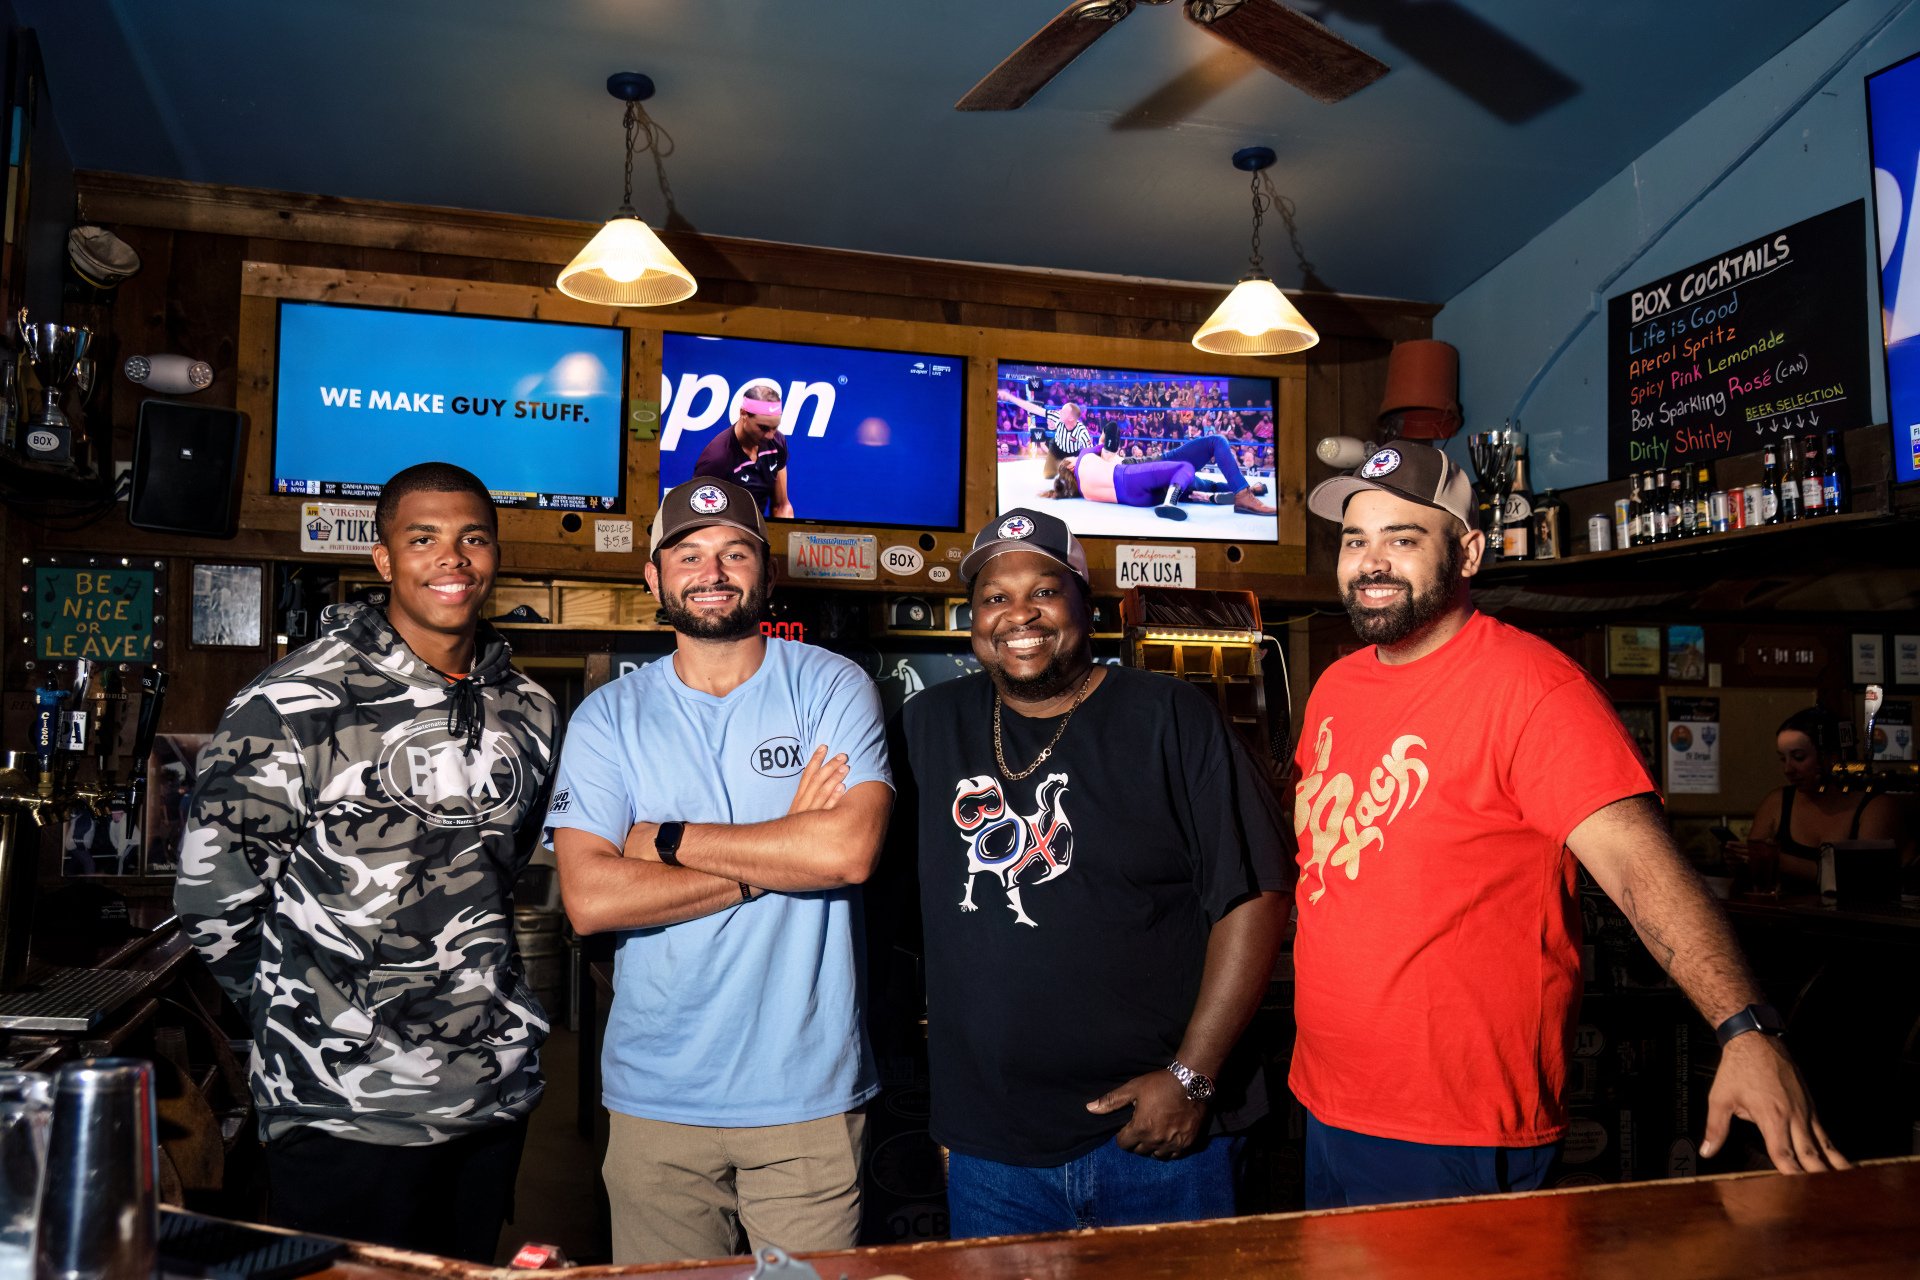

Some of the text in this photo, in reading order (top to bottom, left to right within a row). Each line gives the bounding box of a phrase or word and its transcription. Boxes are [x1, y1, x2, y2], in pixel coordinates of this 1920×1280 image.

[1631, 234, 1790, 324] BOX COCKTAILS
[1629, 291, 1738, 354] Life is Good
[1683, 326, 1736, 361] Spritz
[1631, 329, 1785, 405] Spicy Pink Lemonade
[320, 386, 590, 423] WE MAKE GUY STUFF.
[1631, 408, 1654, 432] Box
[1659, 391, 1727, 427] Sparkling
[1728, 368, 1772, 400] Rosé
[1745, 383, 1845, 421] BEER SELECTION
[32, 435, 52, 446] BOX
[1630, 424, 1732, 468] Dirty Shirley
[330, 508, 376, 518] VIRGINIA
[796, 545, 873, 570] ANDSAL
[889, 553, 915, 568] BOX
[948, 551, 962, 559] BOX
[1132, 549, 1177, 561] California
[76, 573, 111, 595] BE
[933, 570, 946, 578] BOX
[1121, 562, 1182, 583] ACK USA
[76, 622, 101, 634] OR
[45, 635, 151, 657] LEAVE!
[759, 744, 803, 771] BOX
[406, 746, 501, 799] BOX
